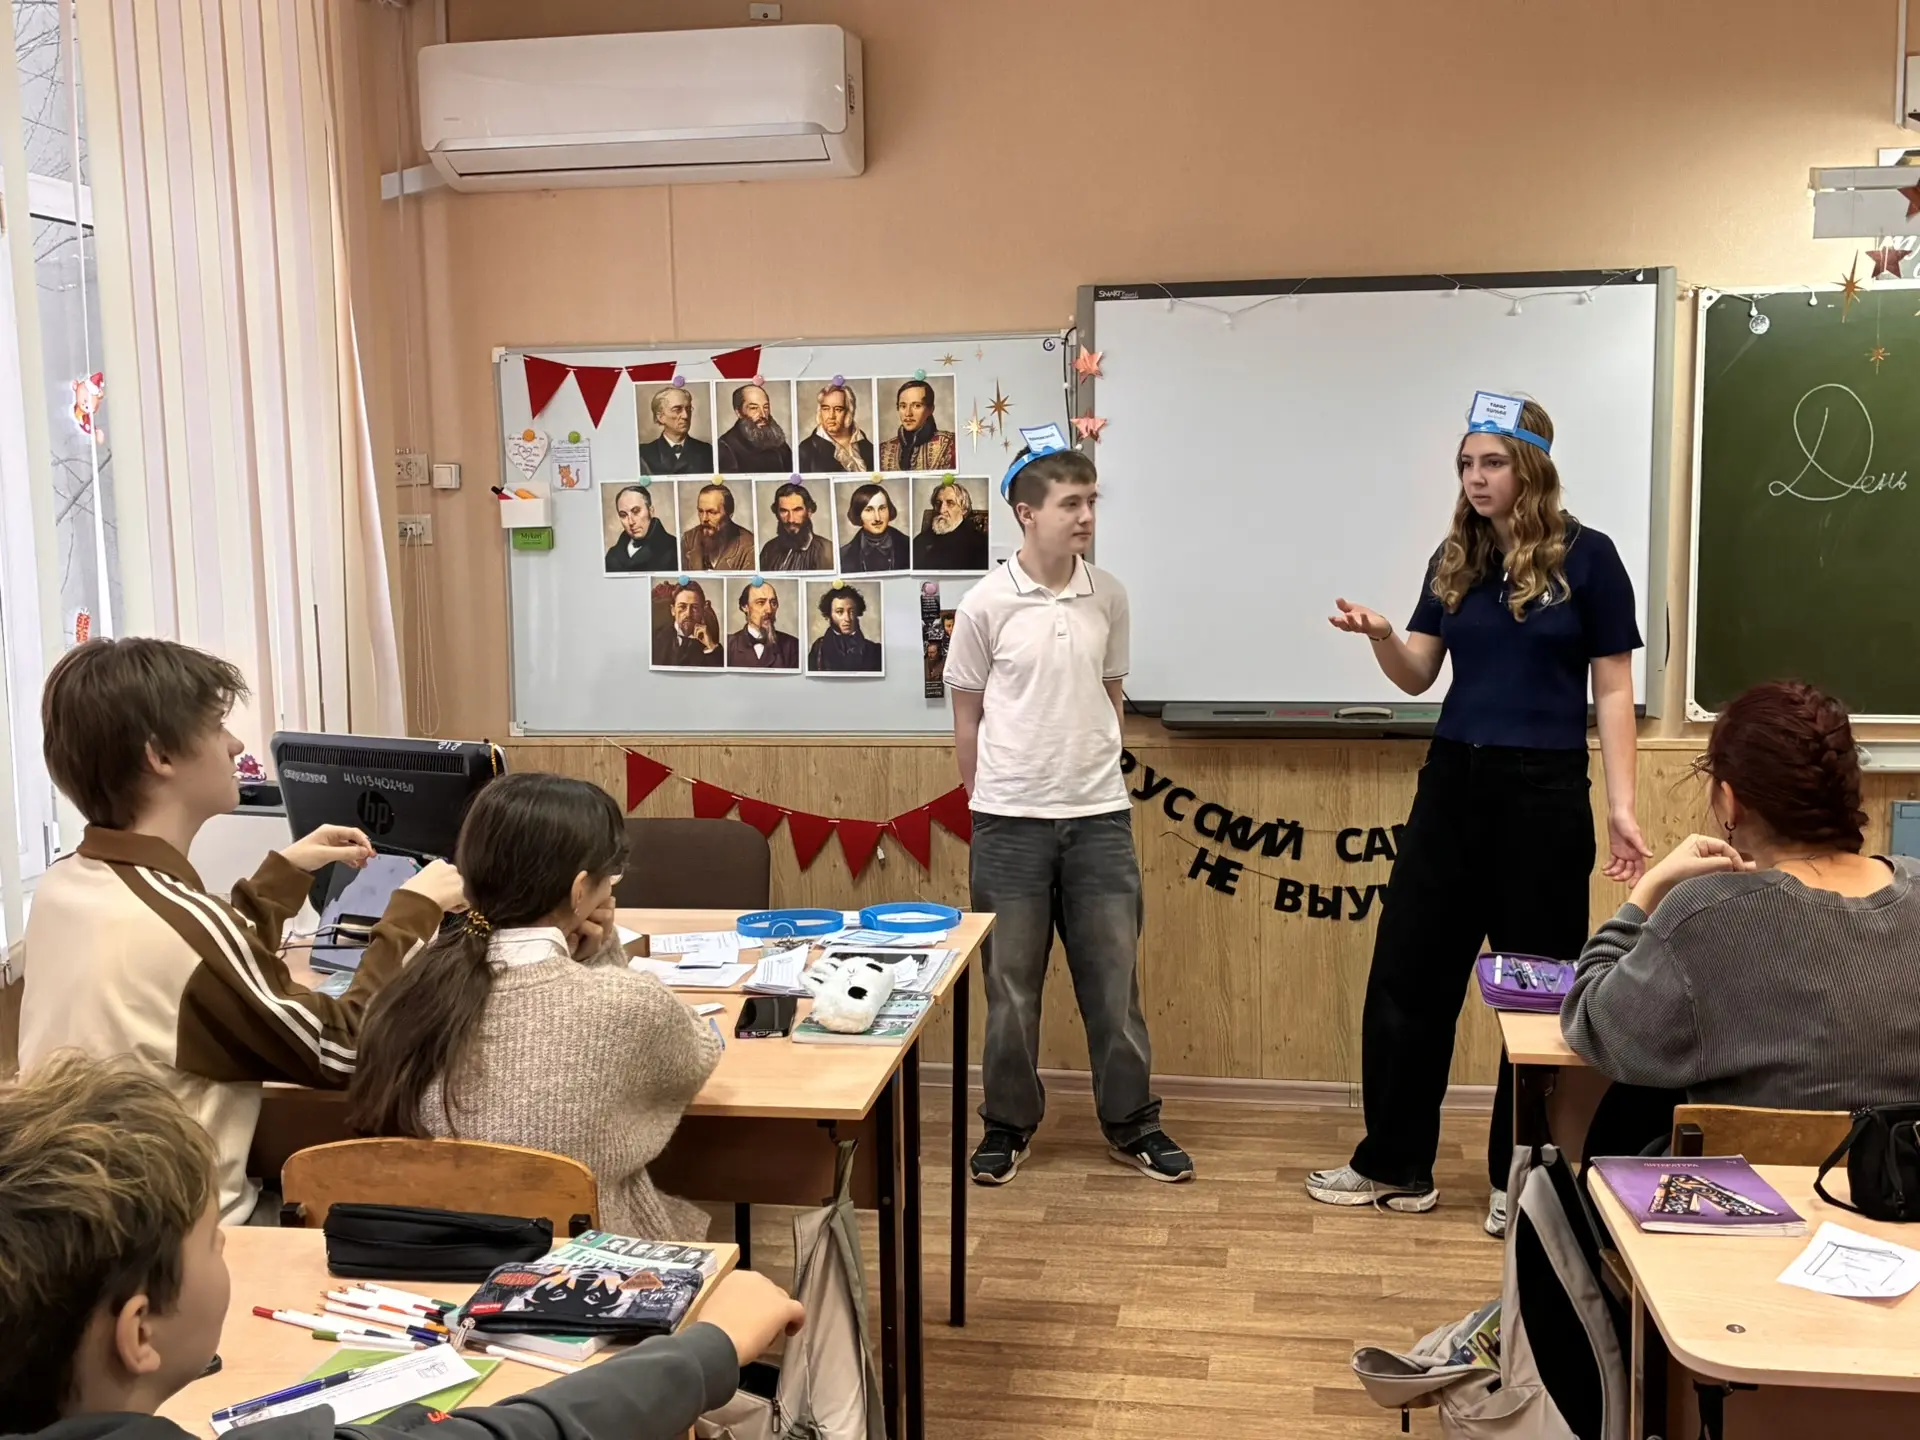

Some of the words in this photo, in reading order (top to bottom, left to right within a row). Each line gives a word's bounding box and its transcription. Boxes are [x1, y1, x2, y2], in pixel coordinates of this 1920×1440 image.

[1098, 290, 1122, 298] SMART
[1767, 383, 1907, 501] День
[364, 793, 388, 835] hp
[1188, 847, 1244, 895] НЕ
[1274, 878, 1387, 920] ВЫУ
